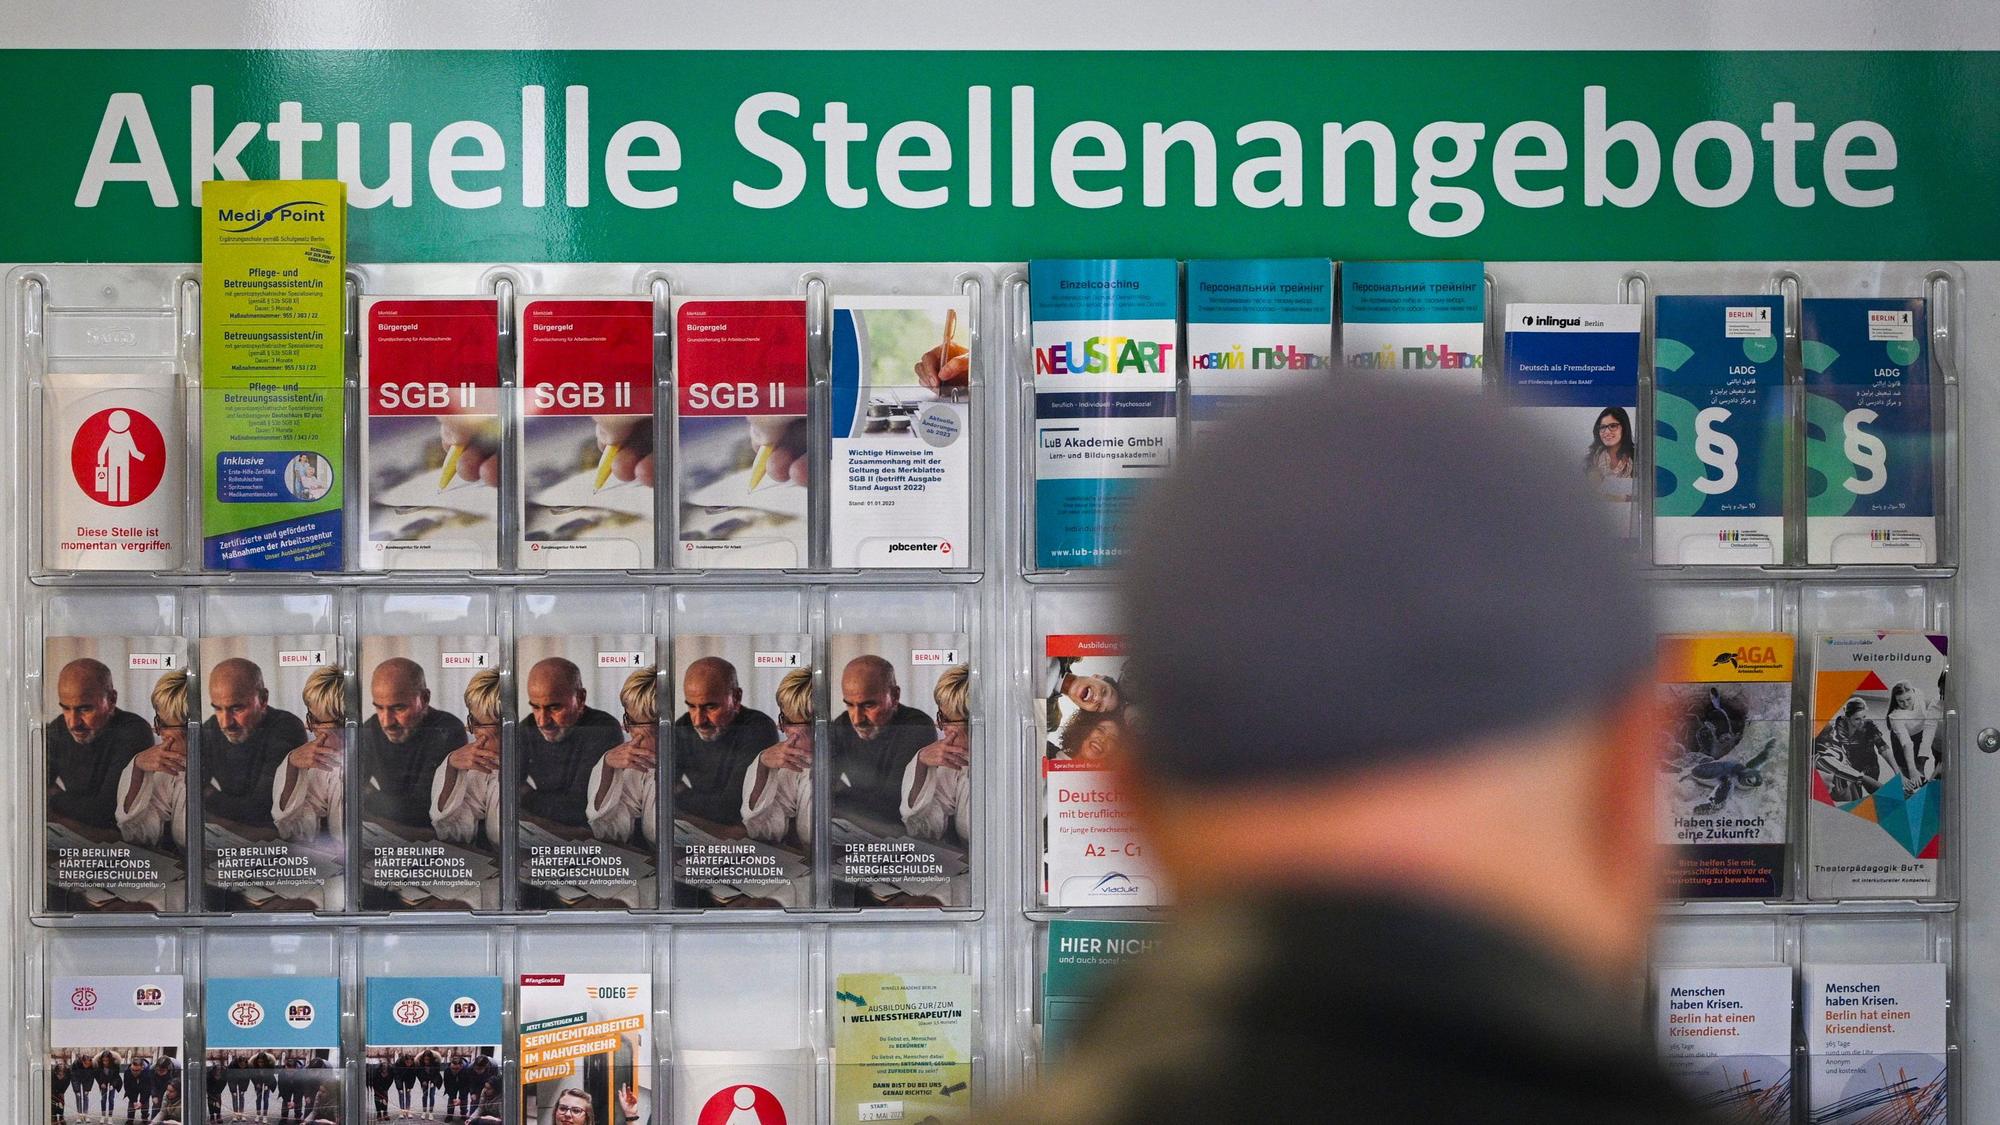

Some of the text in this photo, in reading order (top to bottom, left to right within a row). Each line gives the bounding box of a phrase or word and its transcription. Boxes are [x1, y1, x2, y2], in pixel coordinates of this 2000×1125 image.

[74, 85, 1899, 238] Aktuelle Stellenangebote
[280, 209, 325, 221] Point
[249, 268, 298, 278] Pflege- und
[224, 279, 323, 289] Betreuungsassistent/in
[1060, 280, 1140, 290] Einzelcoaching
[1200, 282, 1324, 294] Персональний трейнінг
[1352, 282, 1477, 293] Персональний трейнінг
[378, 323, 418, 332] Bürgergeld
[533, 323, 573, 332] Bürgergeld
[1536, 316, 1581, 328] inlingua
[686, 324, 727, 332] Bürgergeld
[224, 331, 323, 341] Betreuungsassistent/in
[1036, 336, 1173, 375] NEUSTART
[1729, 366, 1756, 375] LADG
[1874, 368, 1900, 377] LADG
[249, 383, 298, 393] Pflege- und
[224, 394, 323, 404] Betreuungsassistent/in
[379, 382, 476, 408] SGB II
[534, 382, 630, 408] SGB II
[688, 382, 785, 409] SGB II
[928, 415, 954, 425] Aktuelle
[1045, 437, 1163, 448] LuB Akademie GmbH
[223, 457, 264, 465] Inklusive
[1085, 452, 1156, 460] Bildungsakademie
[77, 527, 159, 537] Diese Stelle ist
[220, 523, 316, 549] Zertifizierte und geförderte
[61, 542, 117, 550] momentan
[222, 546, 265, 560] Maßnahmen
[280, 531, 333, 548] Arbeitsagentur
[888, 543, 938, 553] jobcenter
[1737, 647, 1776, 663] AGA
[1852, 653, 1932, 663] Weiterbildung
[1060, 810, 1075, 818] mit
[1674, 816, 1764, 827] Haben sie noch
[1706, 829, 1760, 839] Zukunft?
[59, 848, 130, 858] DER BERLINER
[374, 847, 445, 856] DER BERLINER
[845, 843, 915, 853] DER BERLINER
[1085, 843, 1142, 857] A2 C1
[59, 857, 150, 869] HÄRTEFALLFONDS
[374, 856, 465, 867] HÄRTEFALLFONDS
[845, 852, 935, 864] HÄRTEFALLFONDS
[374, 868, 473, 878] ENERGIESCHULDEN
[845, 864, 943, 874] ENERGIESCHULDEN
[1815, 864, 1897, 873] Theaterpädagogik
[59, 870, 158, 880] ENERGIESCHULDEN
[1060, 937, 1101, 953] HIER
[599, 987, 626, 999] ODEG
[1670, 986, 1725, 997] Menschen
[1826, 983, 1880, 994] Menschen
[868, 1001, 954, 1012] AUSBILDUNG ZUR/ZUM
[1670, 999, 1743, 1010] haben Krisen.
[1826, 996, 1898, 1007] haben Krisen.
[851, 1010, 962, 1023] WELLNESSTHERAPEUT/IN
[1670, 1012, 1755, 1023] Berlin hat einen
[1825, 1009, 1910, 1020] Berlin hat einen
[526, 1024, 540, 1032] JETZT
[542, 1018, 573, 1028] EINSTEIGEN
[1825, 1023, 1895, 1034] Krisendienst.
[525, 1018, 640, 1048] SERVICEMITARBEITER
[1670, 1026, 1740, 1037] Krisendienst.
[525, 1039, 617, 1064] IM NAHVERKEHR
[525, 1063, 570, 1080] (M/W/D)
